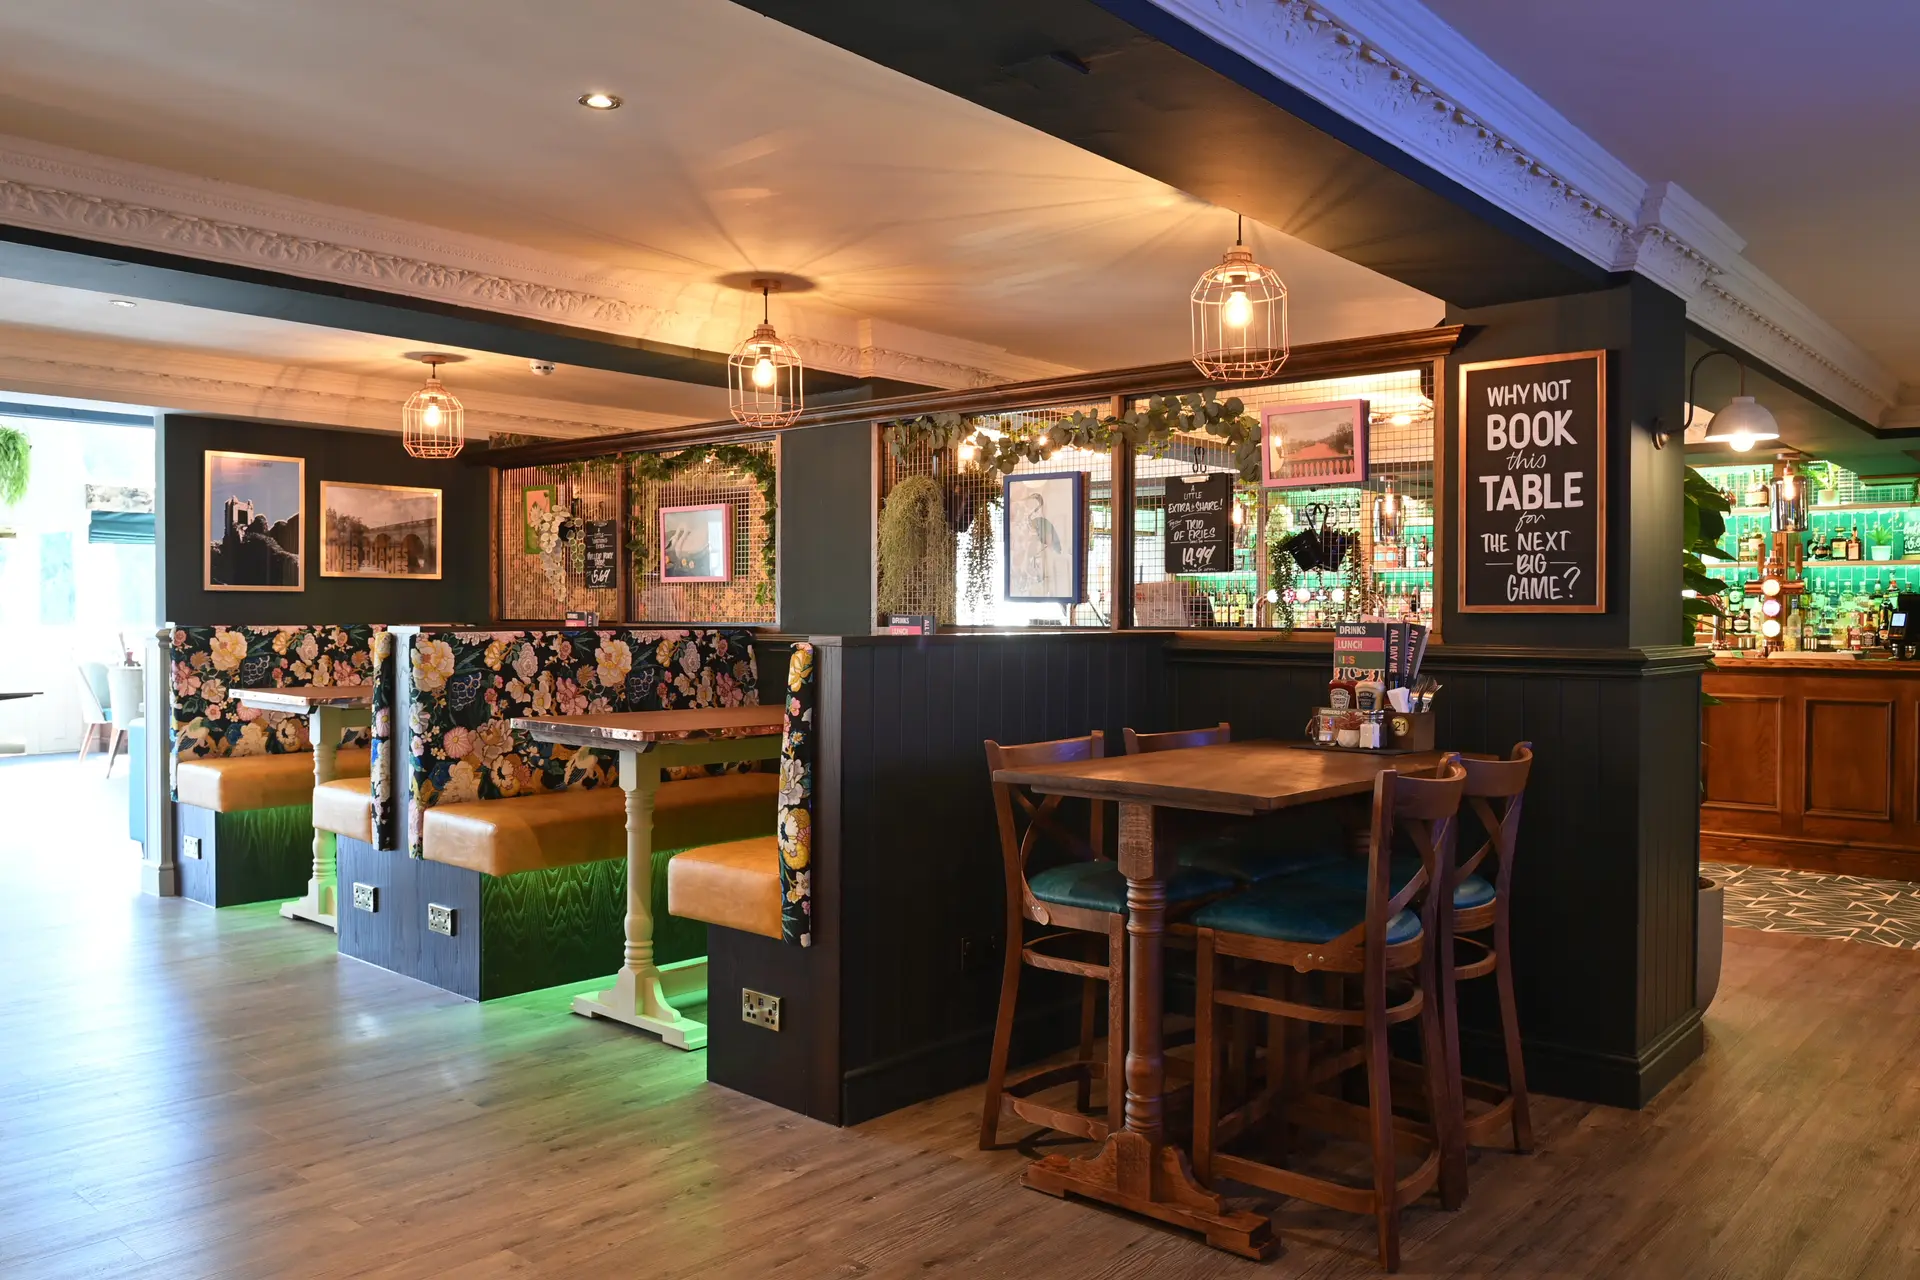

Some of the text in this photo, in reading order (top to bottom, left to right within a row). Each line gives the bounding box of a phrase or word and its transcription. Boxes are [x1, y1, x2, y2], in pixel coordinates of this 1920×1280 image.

[1487, 379, 1571, 407] WHY NOT
[1487, 409, 1578, 451] BOOK
[1506, 449, 1546, 470] this
[1184, 491, 1202, 500] LITTLE
[1479, 472, 1584, 512] TABLE
[1168, 502, 1190, 514] EXTRA
[1185, 519, 1204, 531] TRIO
[1515, 512, 1546, 532] for
[1174, 530, 1185, 541] OF
[1188, 527, 1216, 540] FRIES
[1480, 530, 1571, 553] THE NEXT
[1182, 545, 1216, 567] 14.99
[1516, 553, 1547, 575] BIG
[1507, 566, 1581, 602] GAME?
[1339, 625, 1366, 635] DRINKS
[1390, 629, 1399, 644] ALL
[1337, 639, 1363, 649] LUNCH
[1389, 645, 1399, 661] DAY
[1394, 721, 1406, 732] 21
